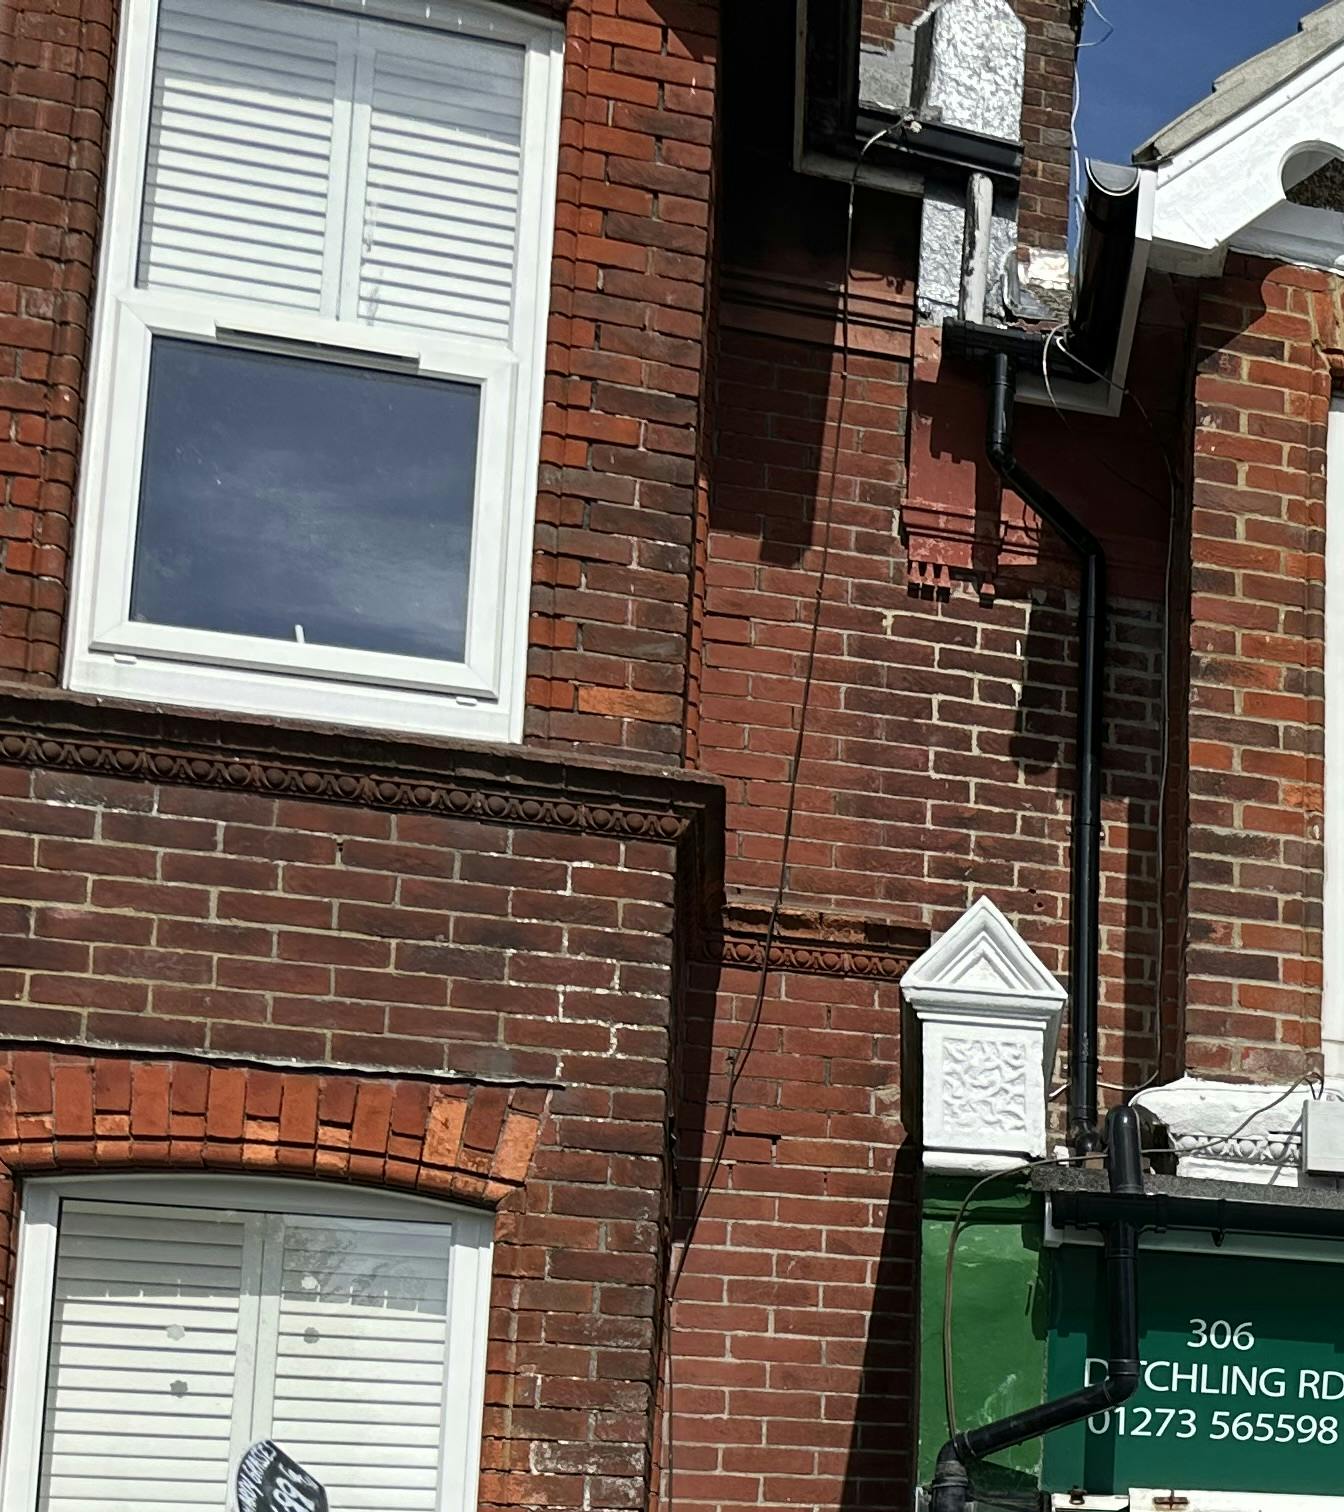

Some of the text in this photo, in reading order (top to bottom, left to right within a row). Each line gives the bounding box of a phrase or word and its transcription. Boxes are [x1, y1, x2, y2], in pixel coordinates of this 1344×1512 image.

[1186, 1318, 1255, 1350] 306
[1084, 1358, 1286, 1397] DCHLING
[1087, 1406, 1338, 1444] 01273 565598
